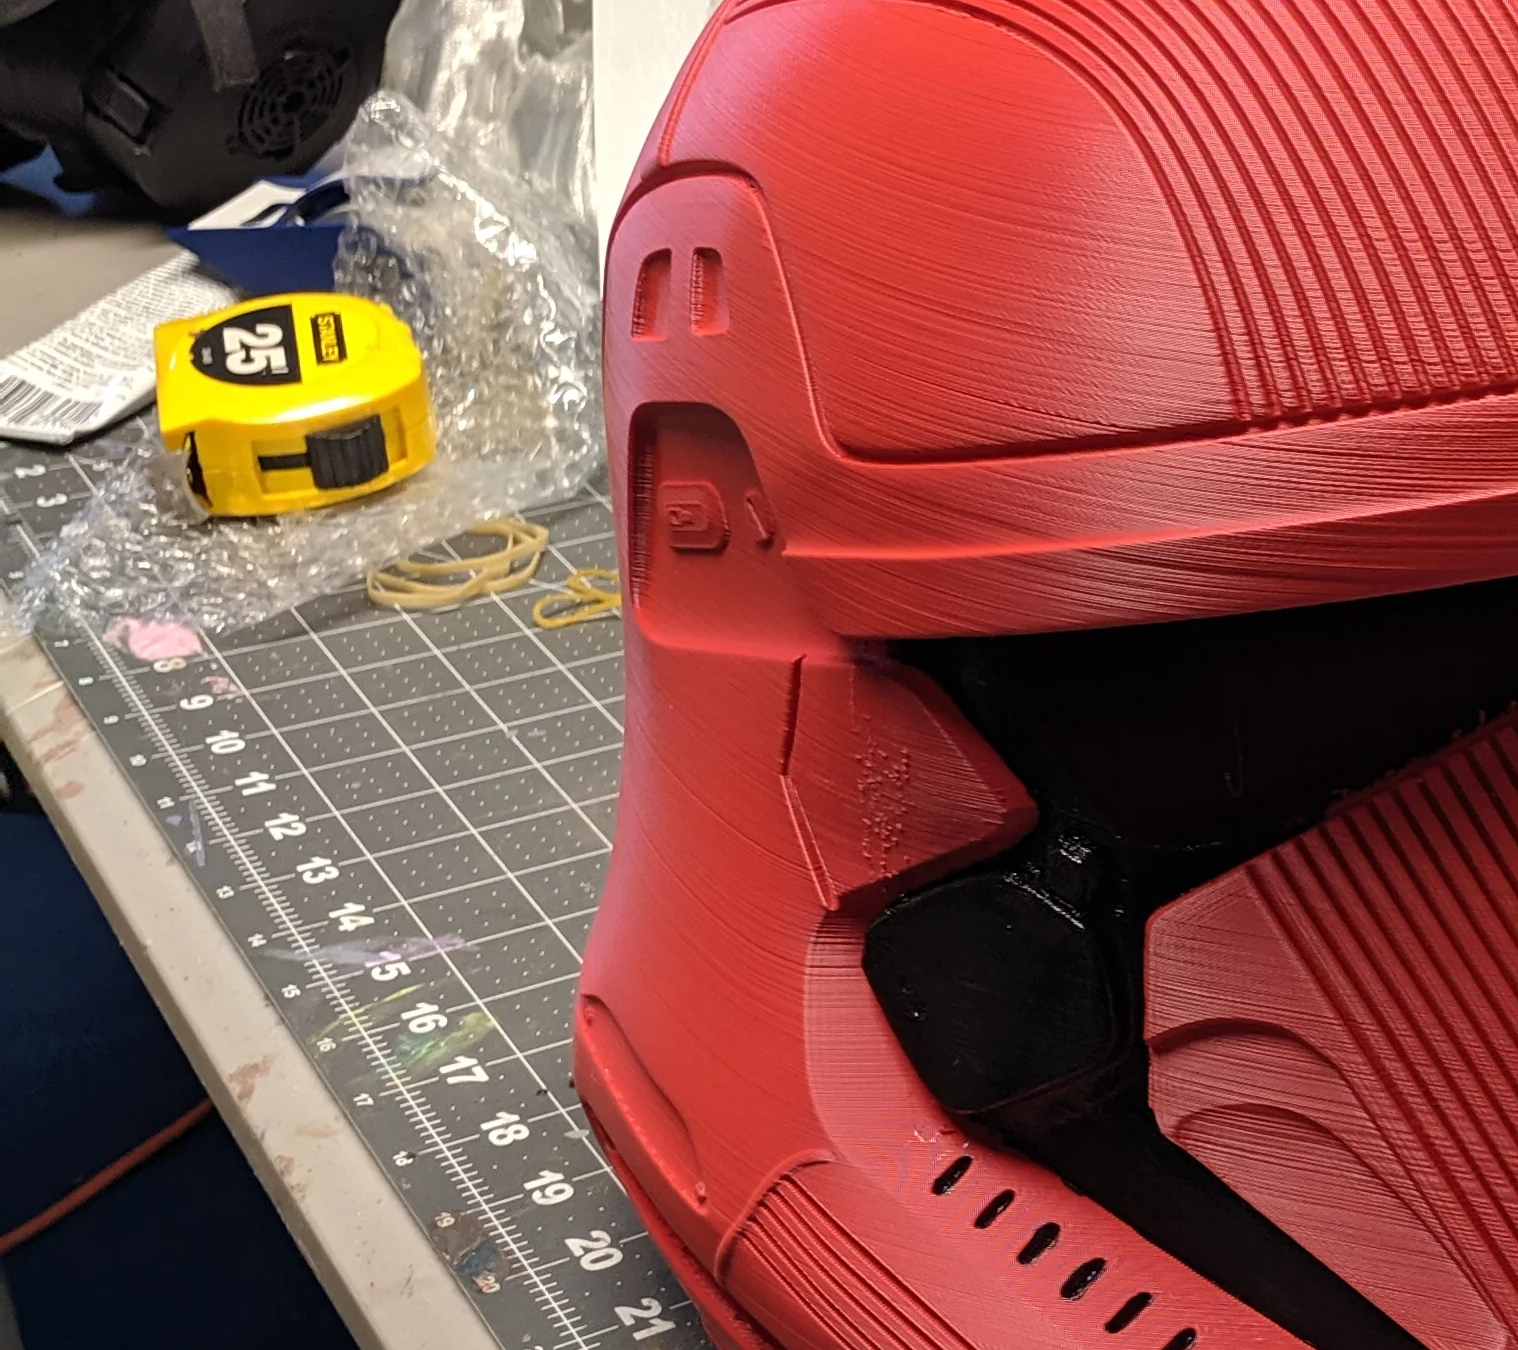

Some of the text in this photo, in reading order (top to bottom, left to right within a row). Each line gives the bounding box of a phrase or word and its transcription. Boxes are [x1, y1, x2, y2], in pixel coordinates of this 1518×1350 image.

[317, 313, 340, 363] STANLEY
[153, 657, 187, 673] 8
[180, 694, 214, 711] 9
[205, 729, 246, 754] 10
[234, 771, 277, 797] 11
[264, 812, 307, 841] 12
[296, 856, 340, 884] 13
[328, 902, 375, 932] 14
[400, 1002, 448, 1034] 16
[439, 1055, 490, 1084] 17
[480, 1111, 530, 1146] 18
[523, 1169, 575, 1205] 19
[564, 1230, 623, 1271] 20
[614, 1297, 676, 1342] 21
[281, 983, 301, 999] 15
[316, 1037, 337, 1053] 16
[353, 1092, 374, 1107] 17
